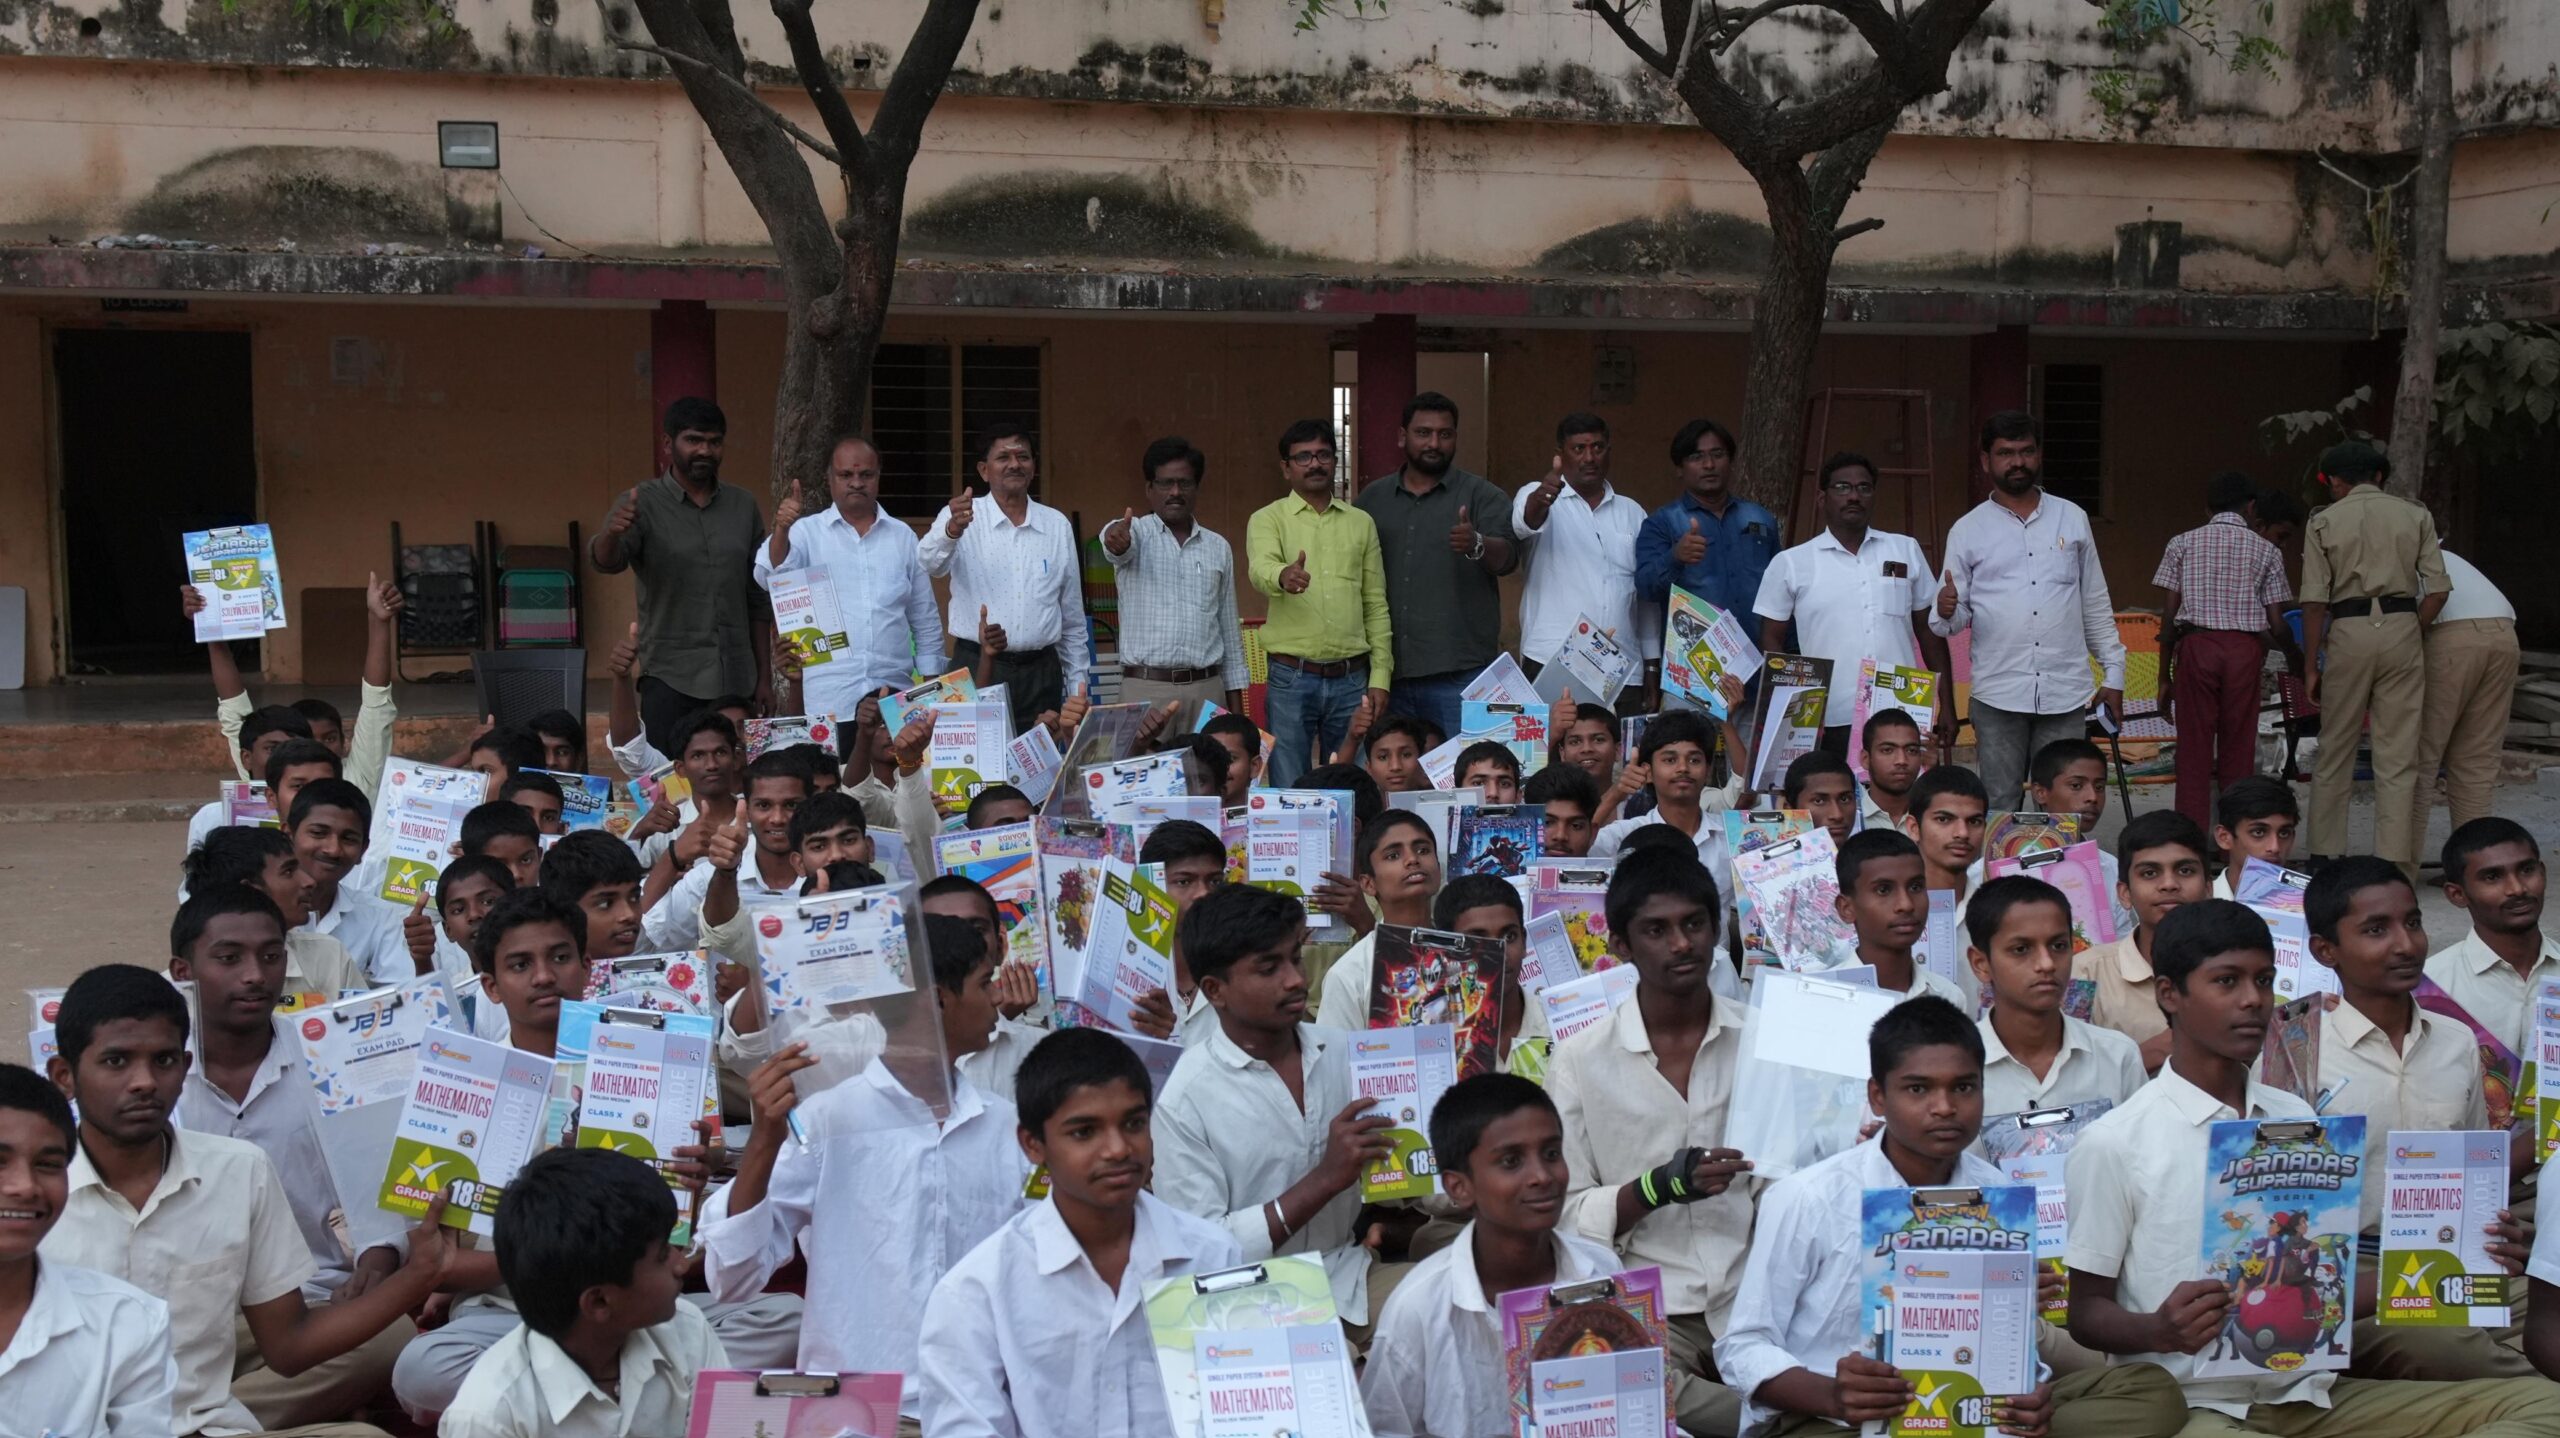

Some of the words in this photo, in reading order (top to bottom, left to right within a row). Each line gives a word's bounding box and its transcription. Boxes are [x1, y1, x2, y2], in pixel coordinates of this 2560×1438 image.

[214, 569, 227, 581] 18
[775, 595, 812, 614] MATHEMATICS
[813, 638, 827, 653] 18
[1895, 676, 1905, 690] 18
[934, 731, 976, 747] MATHEMATICS
[967, 783, 981, 798] 18
[399, 821, 446, 843] MATHEMATICS
[1252, 841, 1299, 857] MATHEMATICS
[390, 885, 416, 895] GRADE
[1129, 890, 1143, 914] 18
[809, 947, 836, 957] EXAM
[838, 943, 858, 953] PAD
[356, 1043, 384, 1056] EXAM
[385, 1038, 405, 1048] PAD
[591, 1071, 658, 1100] MATHEMATICS
[1358, 1073, 1417, 1098] MATHEMATICS
[415, 1080, 493, 1119] MATHEMATICS
[587, 1108, 615, 1117] CLASS
[408, 1119, 438, 1132] CLASS
[440, 1127, 448, 1135] X
[1409, 1151, 1430, 1175] 18
[2219, 1152, 2360, 1185] JORNADAS
[1371, 1171, 1403, 1183] GRADE
[2233, 1171, 2343, 1197] SUPREMAS
[395, 1184, 435, 1202] GRADE
[451, 1179, 475, 1207] 18
[2391, 1188, 2462, 1211] MATHEMATICS
[1874, 1227, 2029, 1257] JORNADAS
[2390, 1229, 2420, 1237] CLASS
[2441, 1276, 2464, 1304] 18
[2391, 1297, 2431, 1308] GRADE
[1901, 1306, 1979, 1331] MATHEMATICS
[2385, 1310, 2407, 1319] MODEL
[2409, 1309, 2437, 1318] PAPERS
[1901, 1348, 1932, 1356] CLASS
[1934, 1349, 1942, 1357] X
[1210, 1386, 1294, 1415] MATHEMATICS
[1958, 1399, 1983, 1426] 18
[1544, 1416, 1616, 1438] MATHEMATICS
[1904, 1417, 1947, 1429] GRADE
